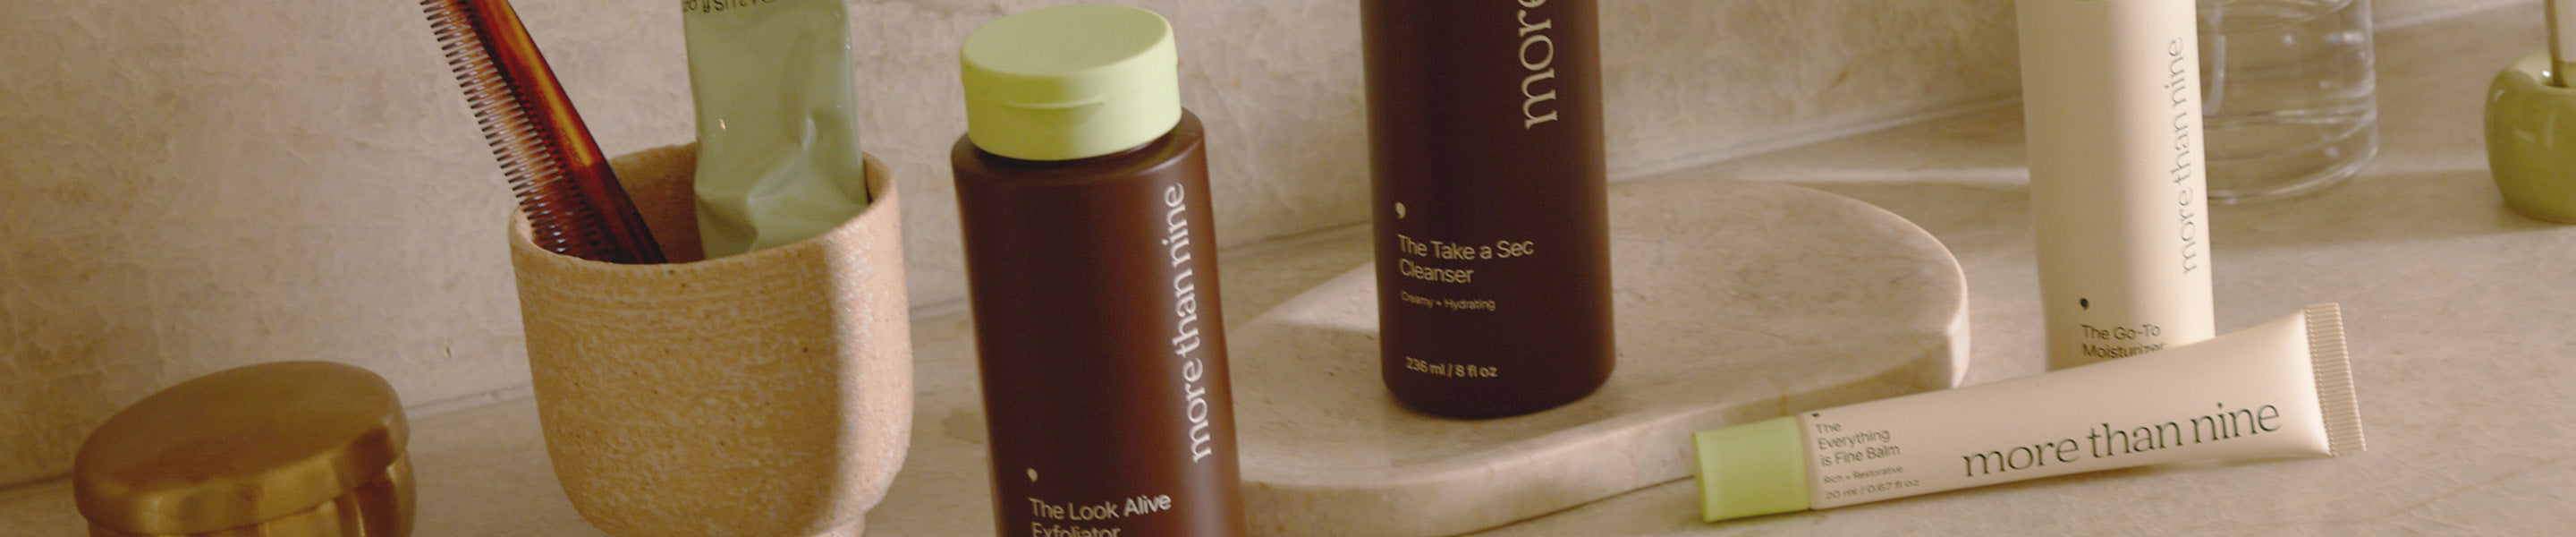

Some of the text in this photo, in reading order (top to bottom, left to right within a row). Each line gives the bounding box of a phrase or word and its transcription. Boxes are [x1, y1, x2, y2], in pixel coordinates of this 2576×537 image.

[1518, 0, 1557, 129] mor
[2165, 36, 2198, 275] more than nine
[1397, 234, 1535, 260] The Take a Sec
[1399, 259, 1475, 284] Cleanser
[1401, 291, 1433, 309] Creamy
[1445, 298, 1496, 311] Hydrating
[1161, 183, 1212, 463] more than nine
[2080, 323, 2161, 341] The Go-To
[1428, 363, 1445, 376] ml
[1454, 364, 1466, 378] 8
[1479, 366, 1498, 378] oz
[1815, 422, 1843, 434] The
[1963, 402, 2283, 476] more than nine
[1817, 430, 1891, 450] Everything
[1820, 444, 1902, 466] is Fine Balm
[1029, 494, 1172, 521] The Look Alive
[1030, 521, 1122, 537] Exfoliator
